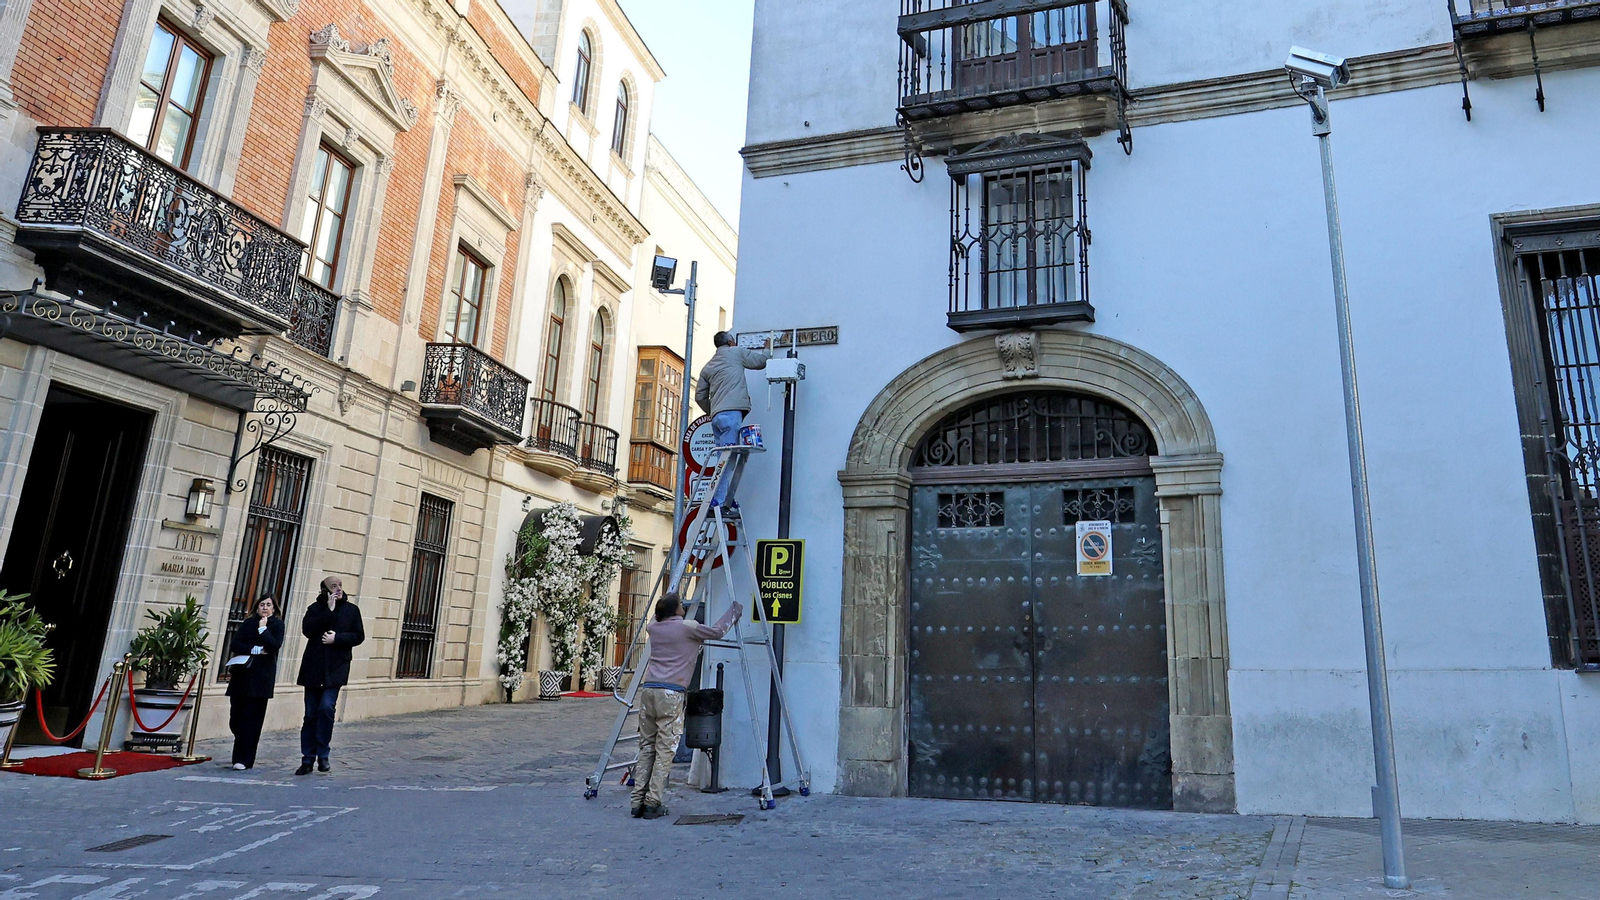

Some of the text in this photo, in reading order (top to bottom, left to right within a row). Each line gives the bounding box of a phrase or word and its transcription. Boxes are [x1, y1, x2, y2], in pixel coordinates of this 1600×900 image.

[770, 547, 789, 575] P
[186, 566, 205, 575] LUISA
[761, 580, 794, 589] PÚBLICO
[772, 591, 793, 599] Cisnes
